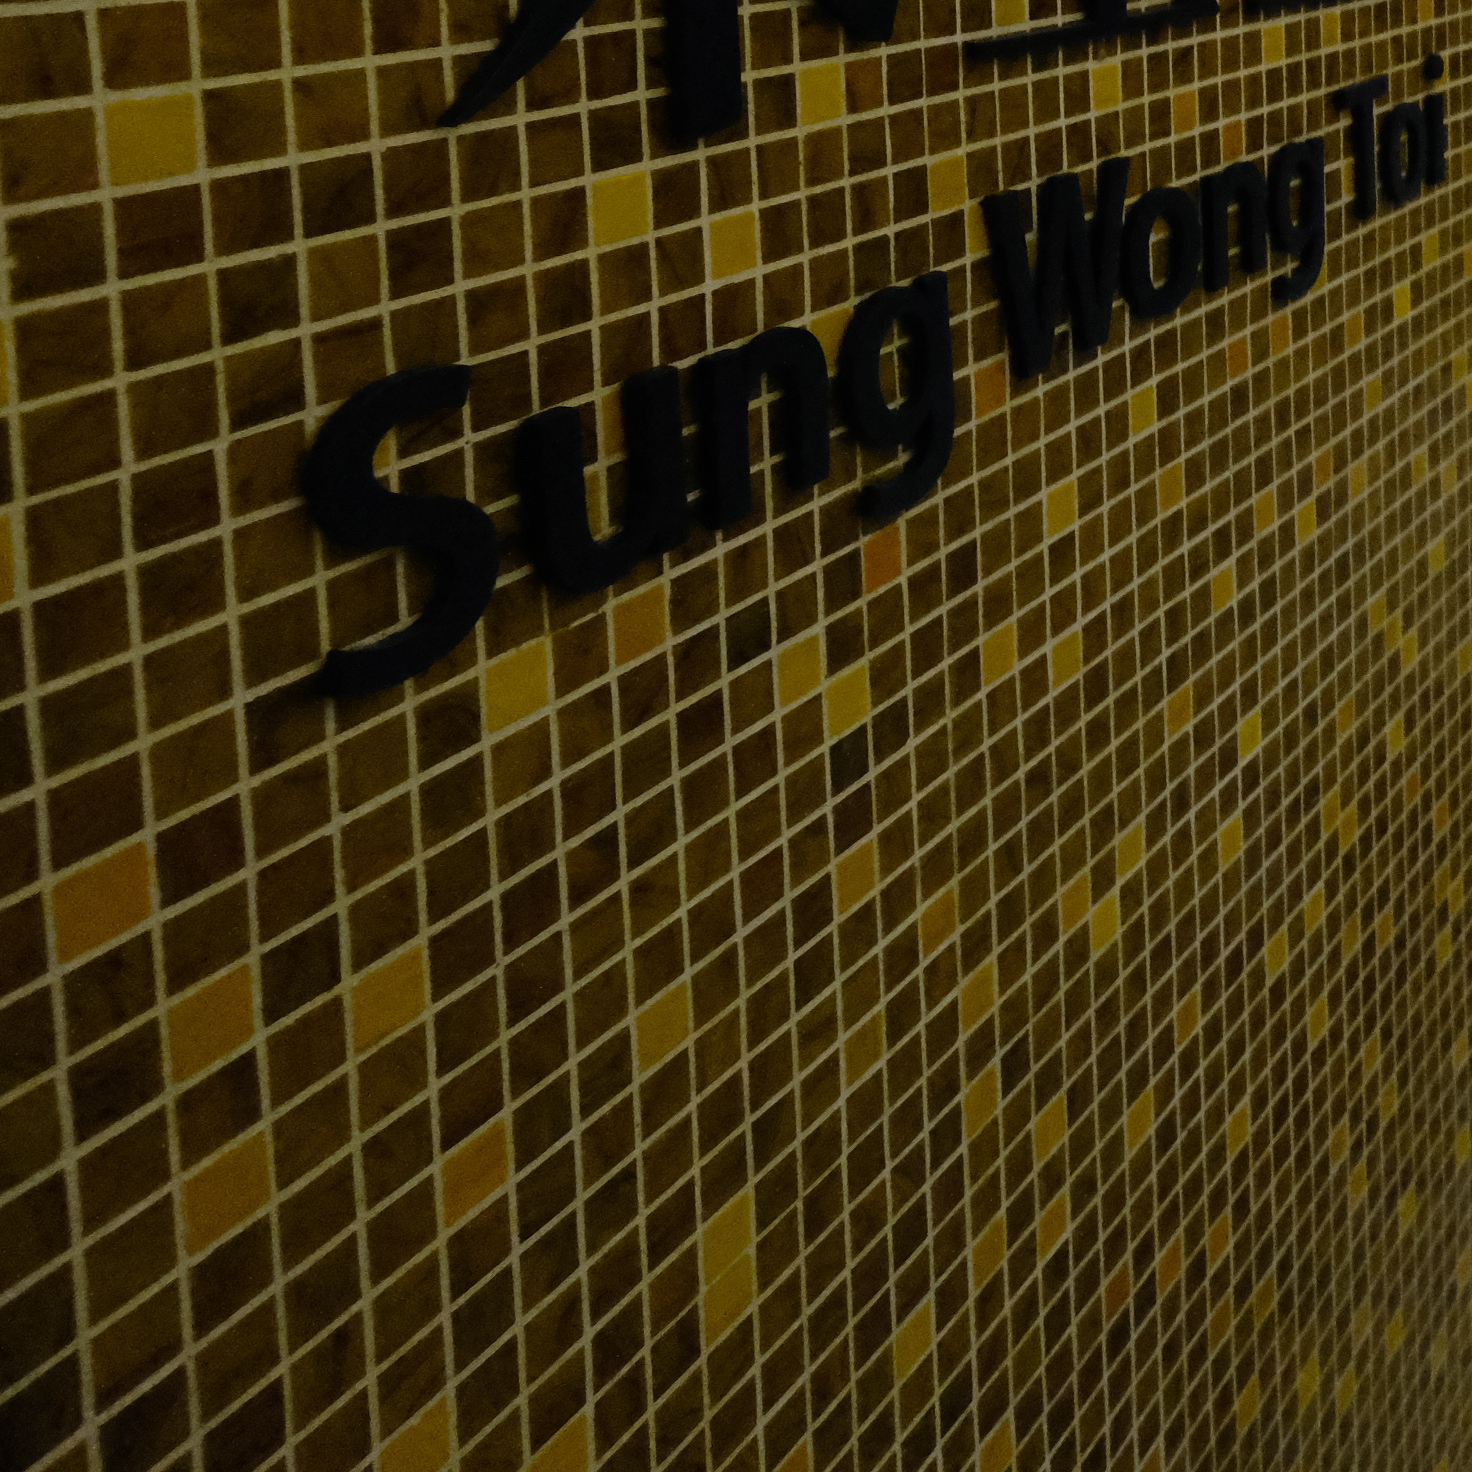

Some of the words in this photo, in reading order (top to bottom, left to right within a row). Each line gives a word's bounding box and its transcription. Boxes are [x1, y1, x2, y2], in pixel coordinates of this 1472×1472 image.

[301, 270, 956, 702] Sung
[983, 137, 1327, 378] Wong
[1334, 55, 1448, 220] Toi
